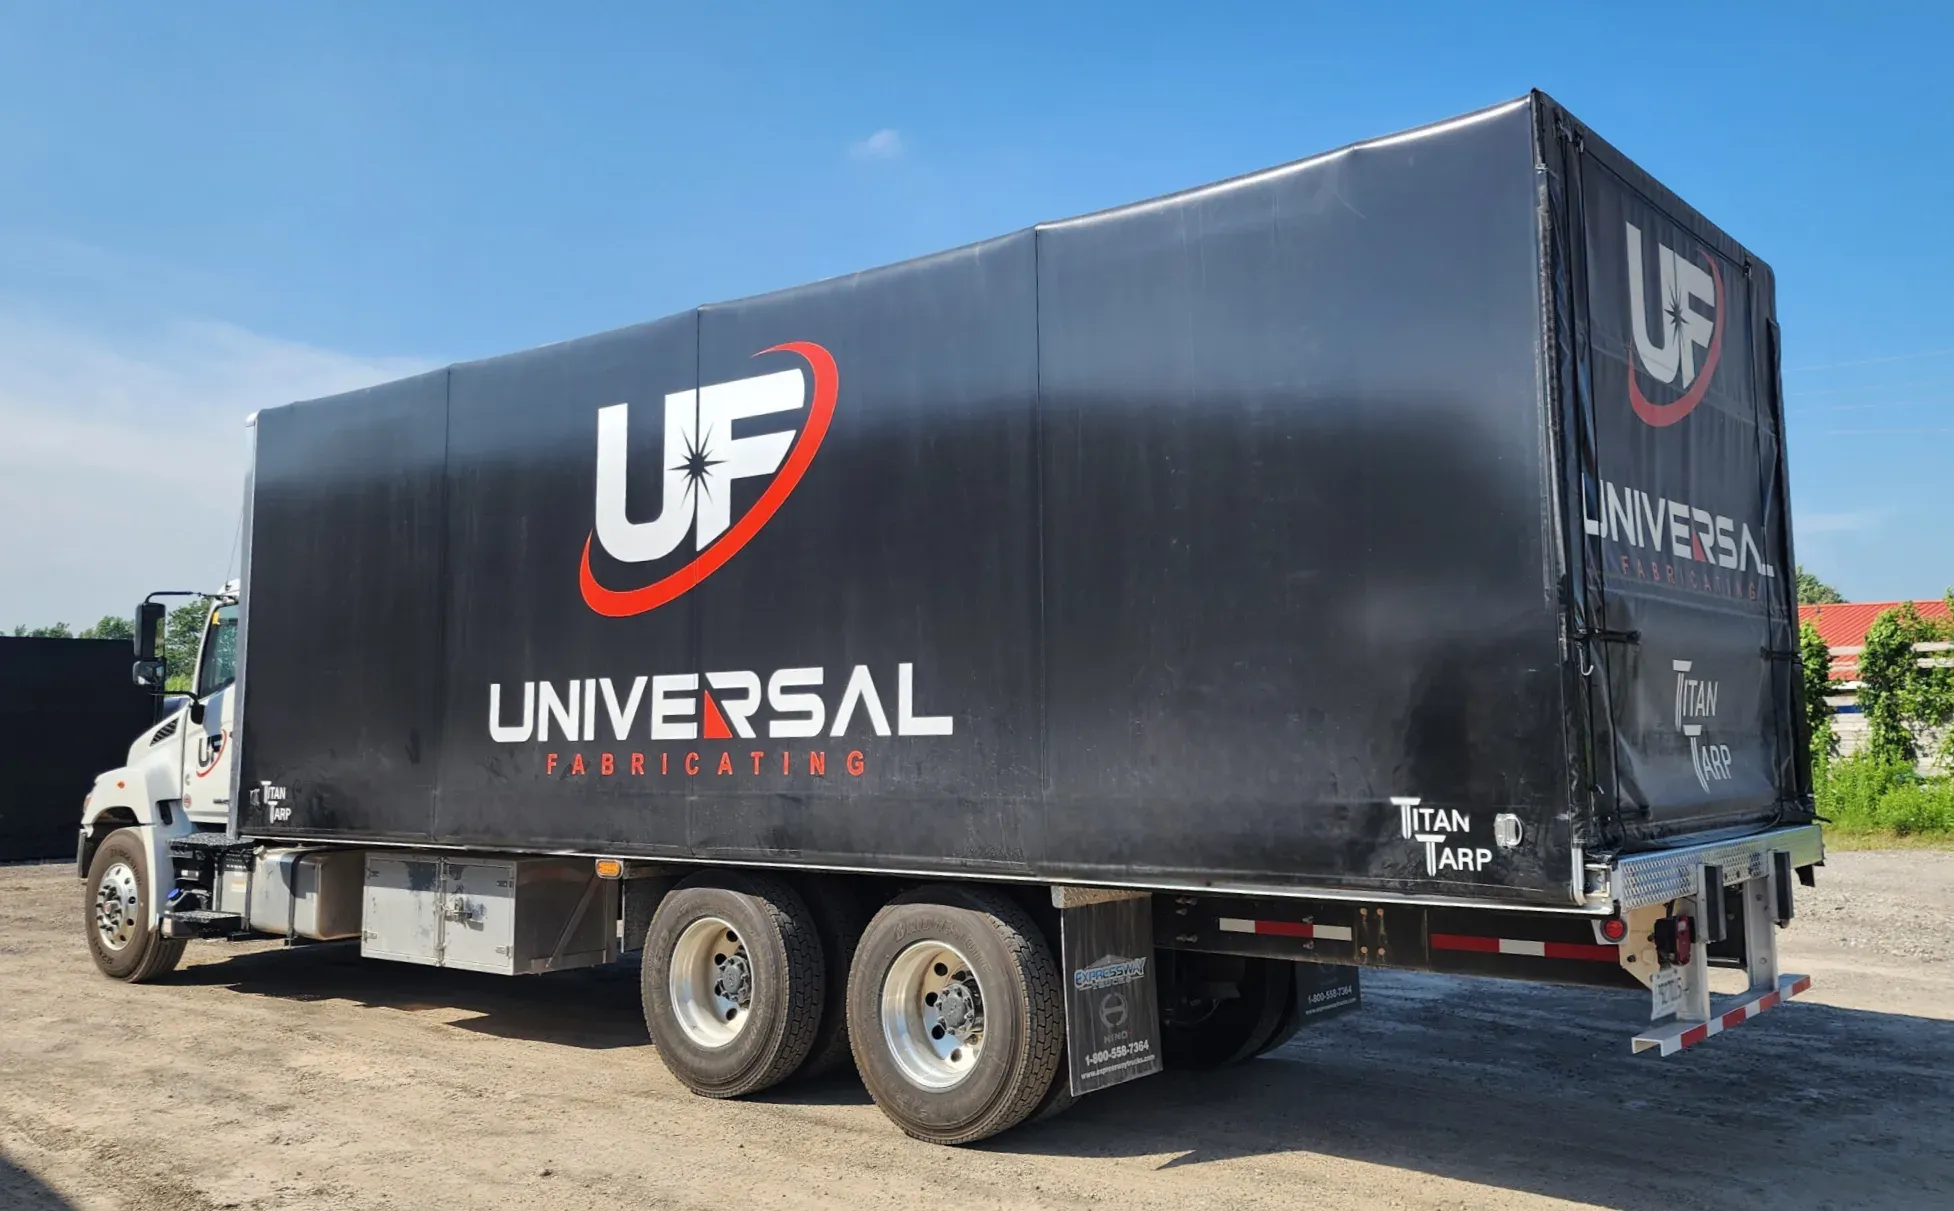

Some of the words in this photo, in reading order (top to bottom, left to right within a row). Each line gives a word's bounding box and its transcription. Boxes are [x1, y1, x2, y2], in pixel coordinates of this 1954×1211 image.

[1626, 221, 1716, 389] UF
[596, 368, 805, 563] UF
[1620, 555, 1757, 600] FABRICATING
[489, 663, 954, 742] UNIVERSAL
[1673, 659, 1718, 732] TITAN
[546, 750, 866, 776] FABRICATING
[1683, 725, 1732, 794] TARP
[261, 781, 286, 804] TITAN
[267, 801, 292, 824] TARP
[1390, 797, 1470, 839] TITAN
[1414, 834, 1493, 877] TARP
[1074, 957, 1147, 988] EXPRESSWAY
[1085, 1039, 1150, 1066] 1-800-558-7364
